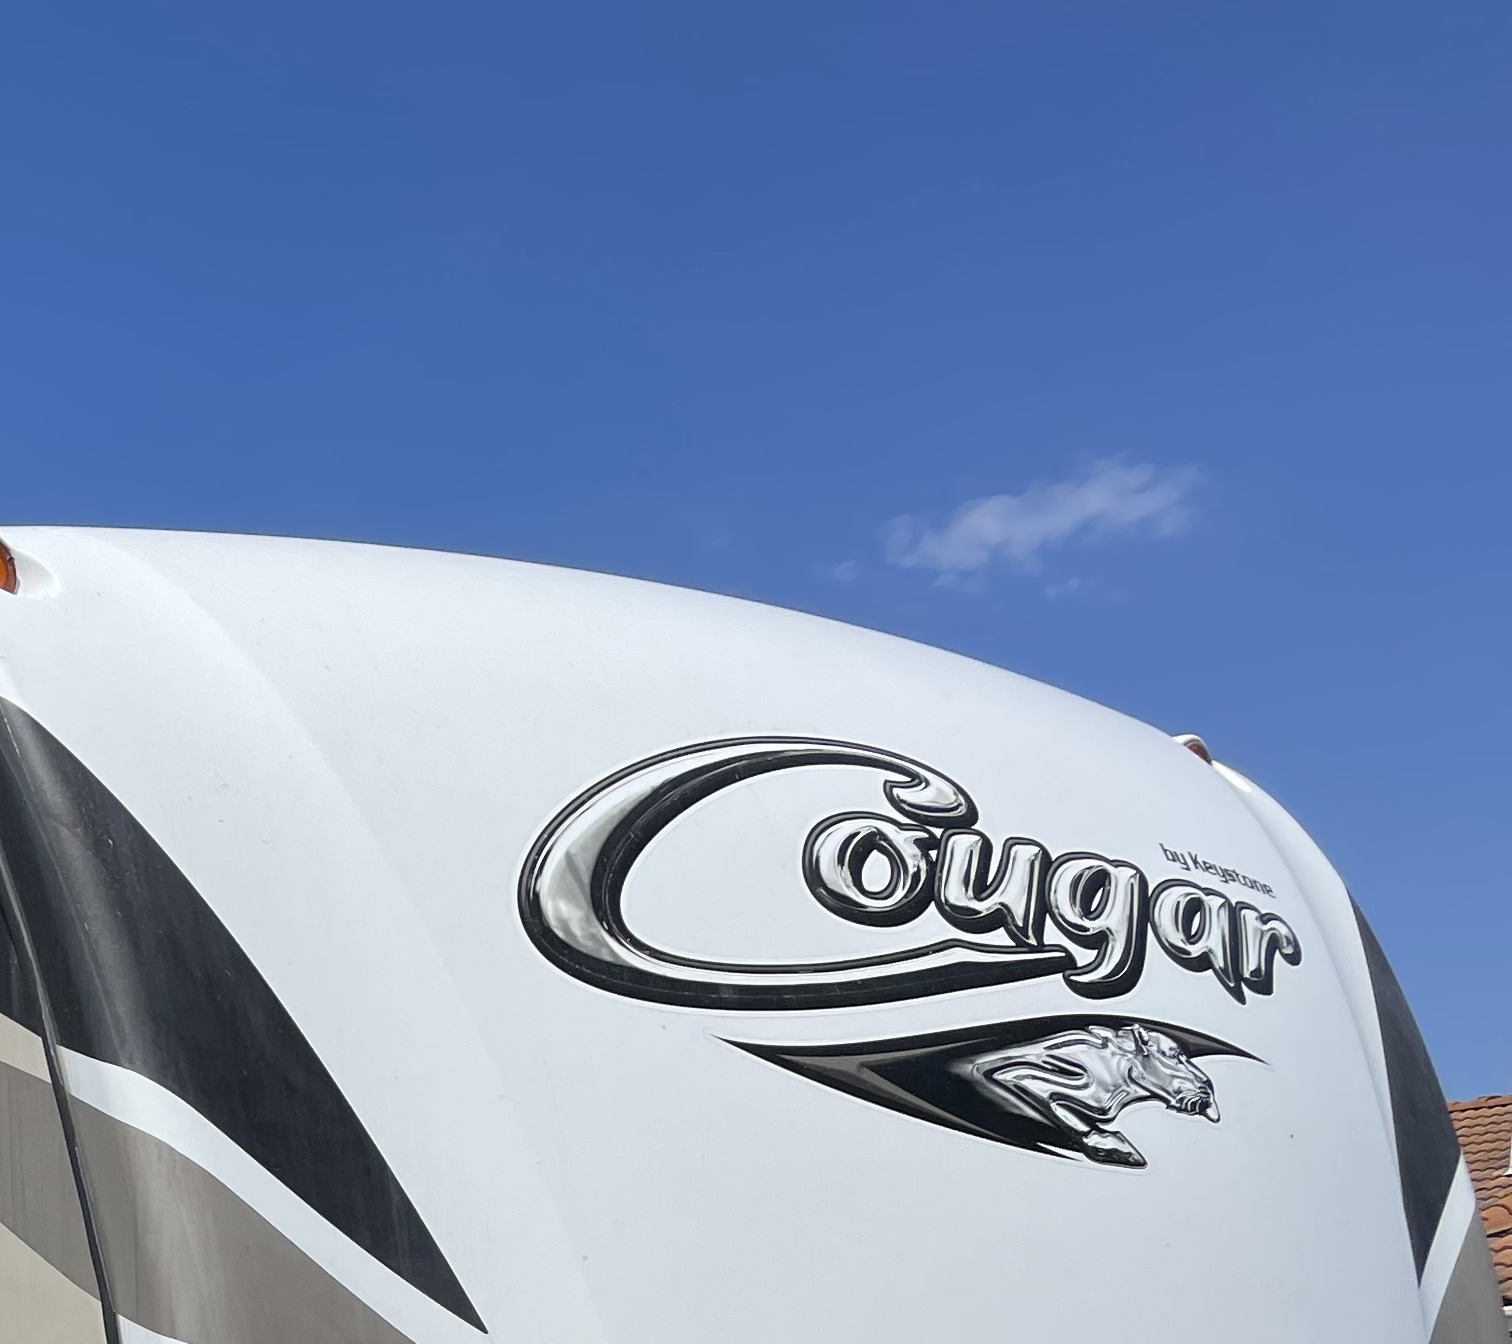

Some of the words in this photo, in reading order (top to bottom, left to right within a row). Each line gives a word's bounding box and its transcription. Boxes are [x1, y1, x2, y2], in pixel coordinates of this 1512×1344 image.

[517, 735, 1302, 1010] Cougar
[1158, 842, 1191, 871] by
[1187, 850, 1277, 898] Keystone
